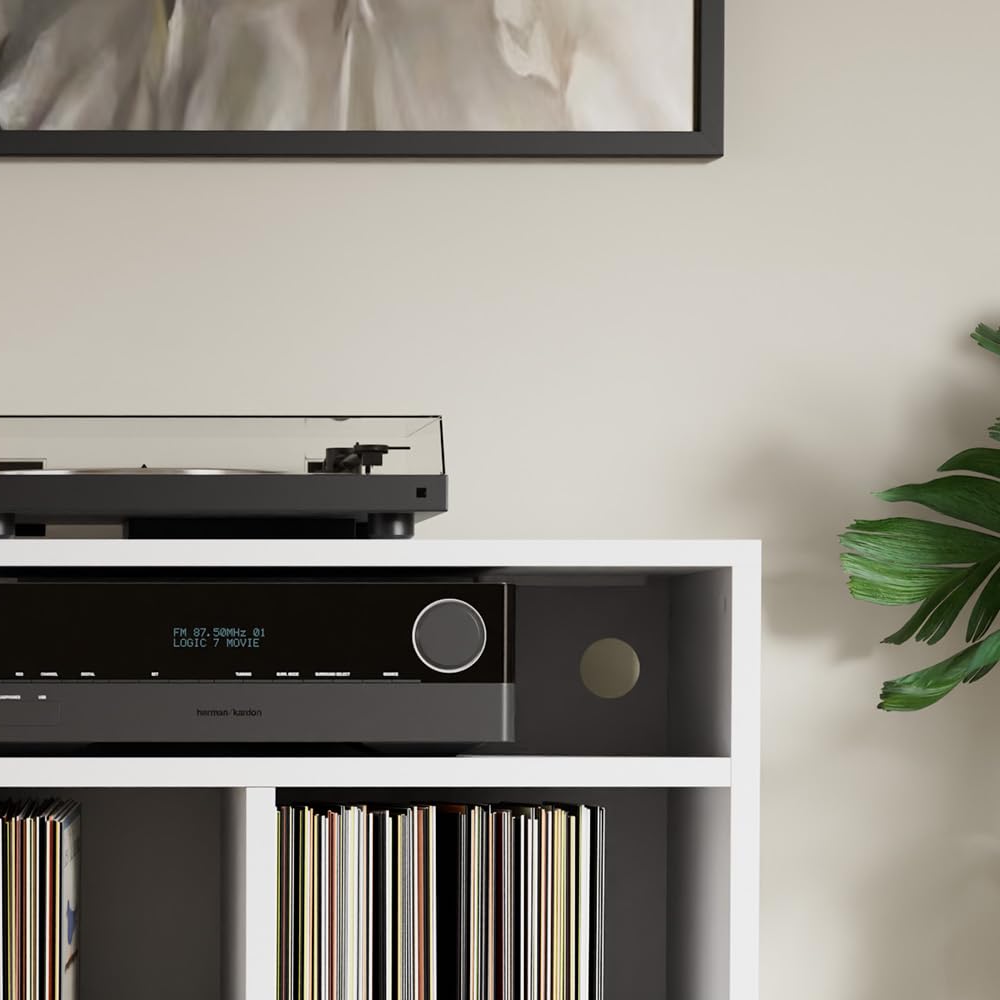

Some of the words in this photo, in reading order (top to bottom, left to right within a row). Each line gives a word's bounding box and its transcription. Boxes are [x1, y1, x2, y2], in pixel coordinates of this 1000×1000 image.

[173, 627, 187, 637] FM
[193, 627, 247, 637] 87.50MHz
[252, 627, 265, 637] 01
[173, 638, 208, 648] LOGIC
[213, 638, 220, 648] 7
[226, 638, 260, 648] MOVIE
